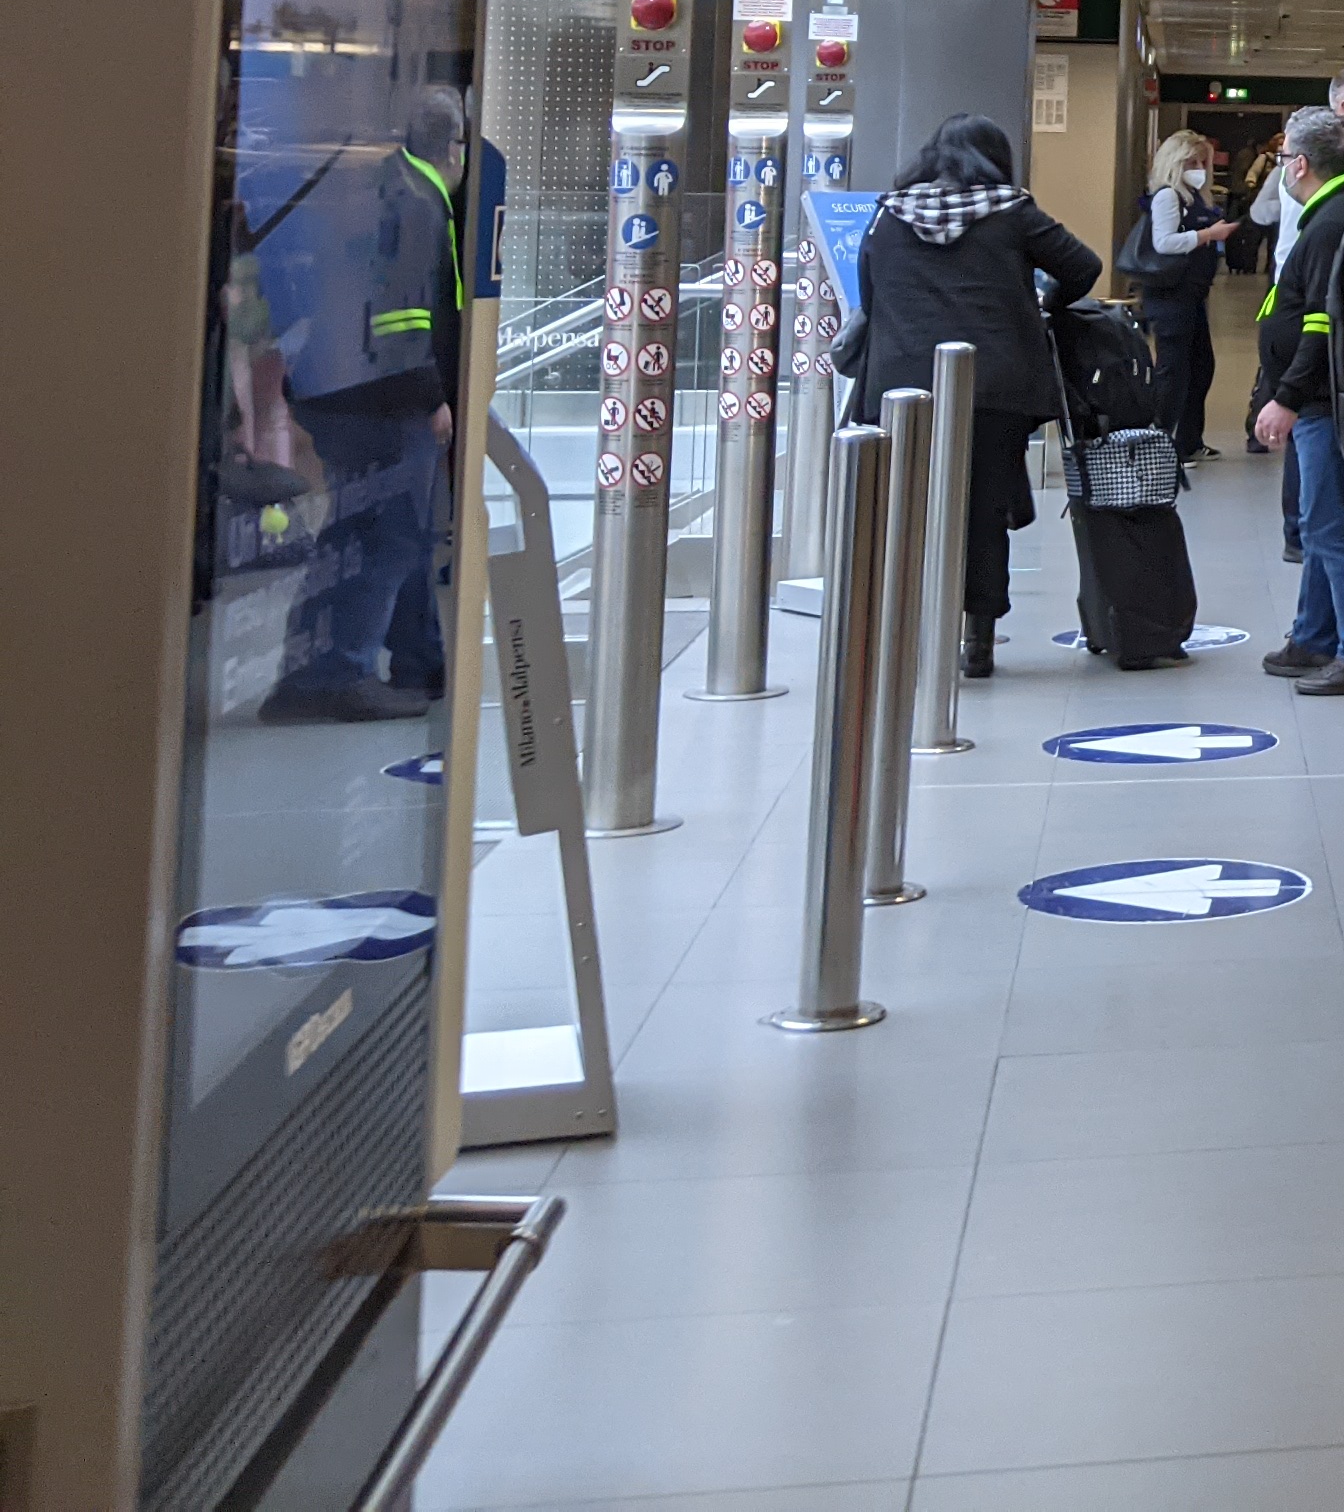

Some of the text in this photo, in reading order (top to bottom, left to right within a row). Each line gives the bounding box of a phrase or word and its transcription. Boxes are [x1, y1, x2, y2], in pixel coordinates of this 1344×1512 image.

[631, 39, 676, 52] STOP
[743, 60, 779, 71] STOP
[815, 73, 846, 82] STOP
[509, 618, 531, 700] Malpensa
